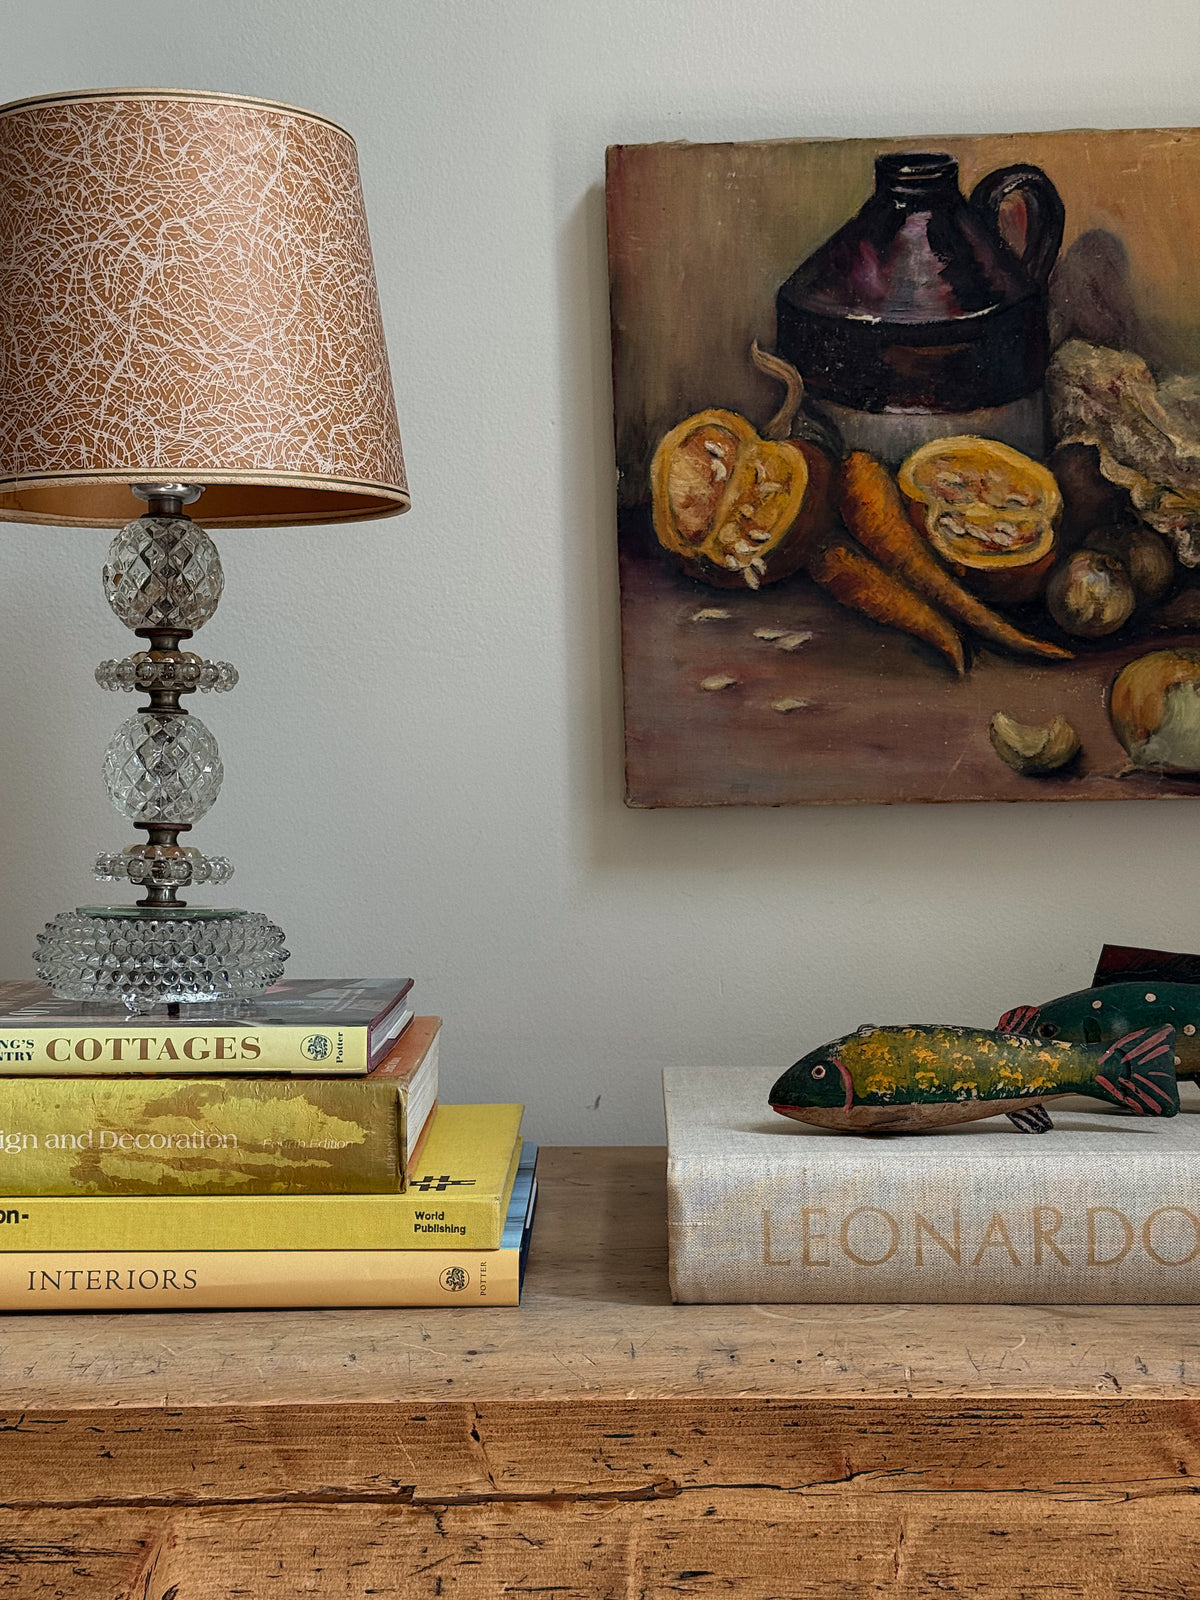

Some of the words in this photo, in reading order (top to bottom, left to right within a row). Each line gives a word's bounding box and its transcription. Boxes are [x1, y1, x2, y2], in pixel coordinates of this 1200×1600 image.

[0, 1051, 35, 1061] TRY
[46, 1037, 261, 1062] COTTAGES
[335, 1031, 344, 1064] Potter
[45, 1130, 93, 1150] and
[99, 1130, 239, 1150] Decoration
[262, 1138, 306, 1150] Fourth
[309, 1137, 354, 1150] Edition
[414, 1211, 445, 1221] World
[414, 1223, 466, 1236] Publishing
[760, 1205, 1200, 1268] LEONARDO
[27, 1269, 197, 1291] INTERIORS
[480, 1261, 488, 1297] POTTER
